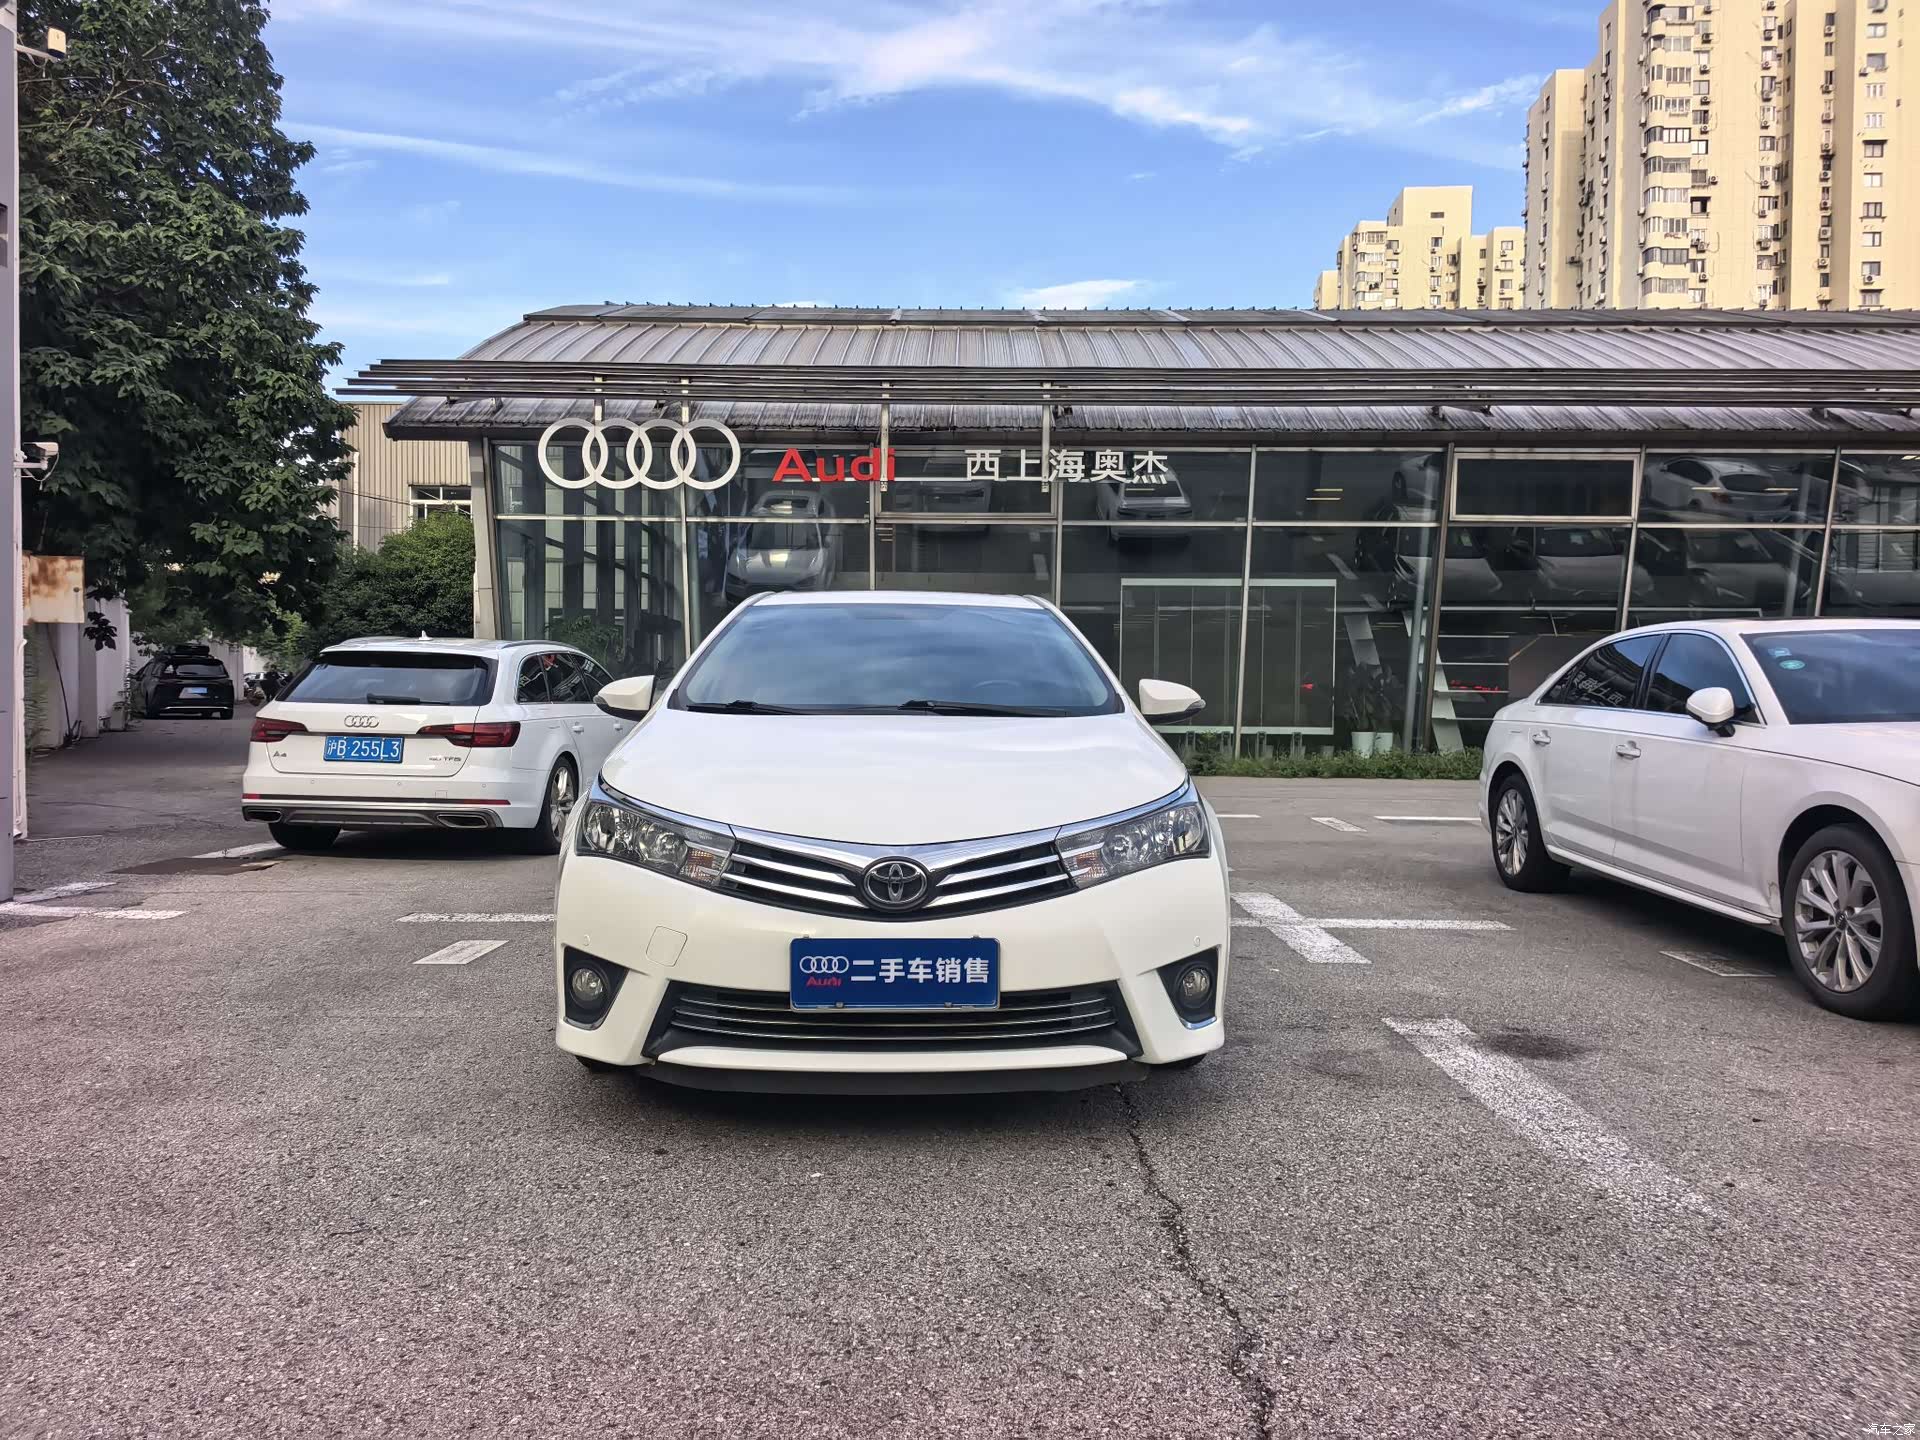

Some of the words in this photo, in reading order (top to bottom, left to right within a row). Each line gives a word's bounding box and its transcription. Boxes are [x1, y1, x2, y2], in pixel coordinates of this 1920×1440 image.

[772, 448, 895, 482] Audi
[965, 449, 1169, 485] 西上海奥杰
[806, 975, 842, 987] Audi
[850, 957, 989, 984] 二手车销售
